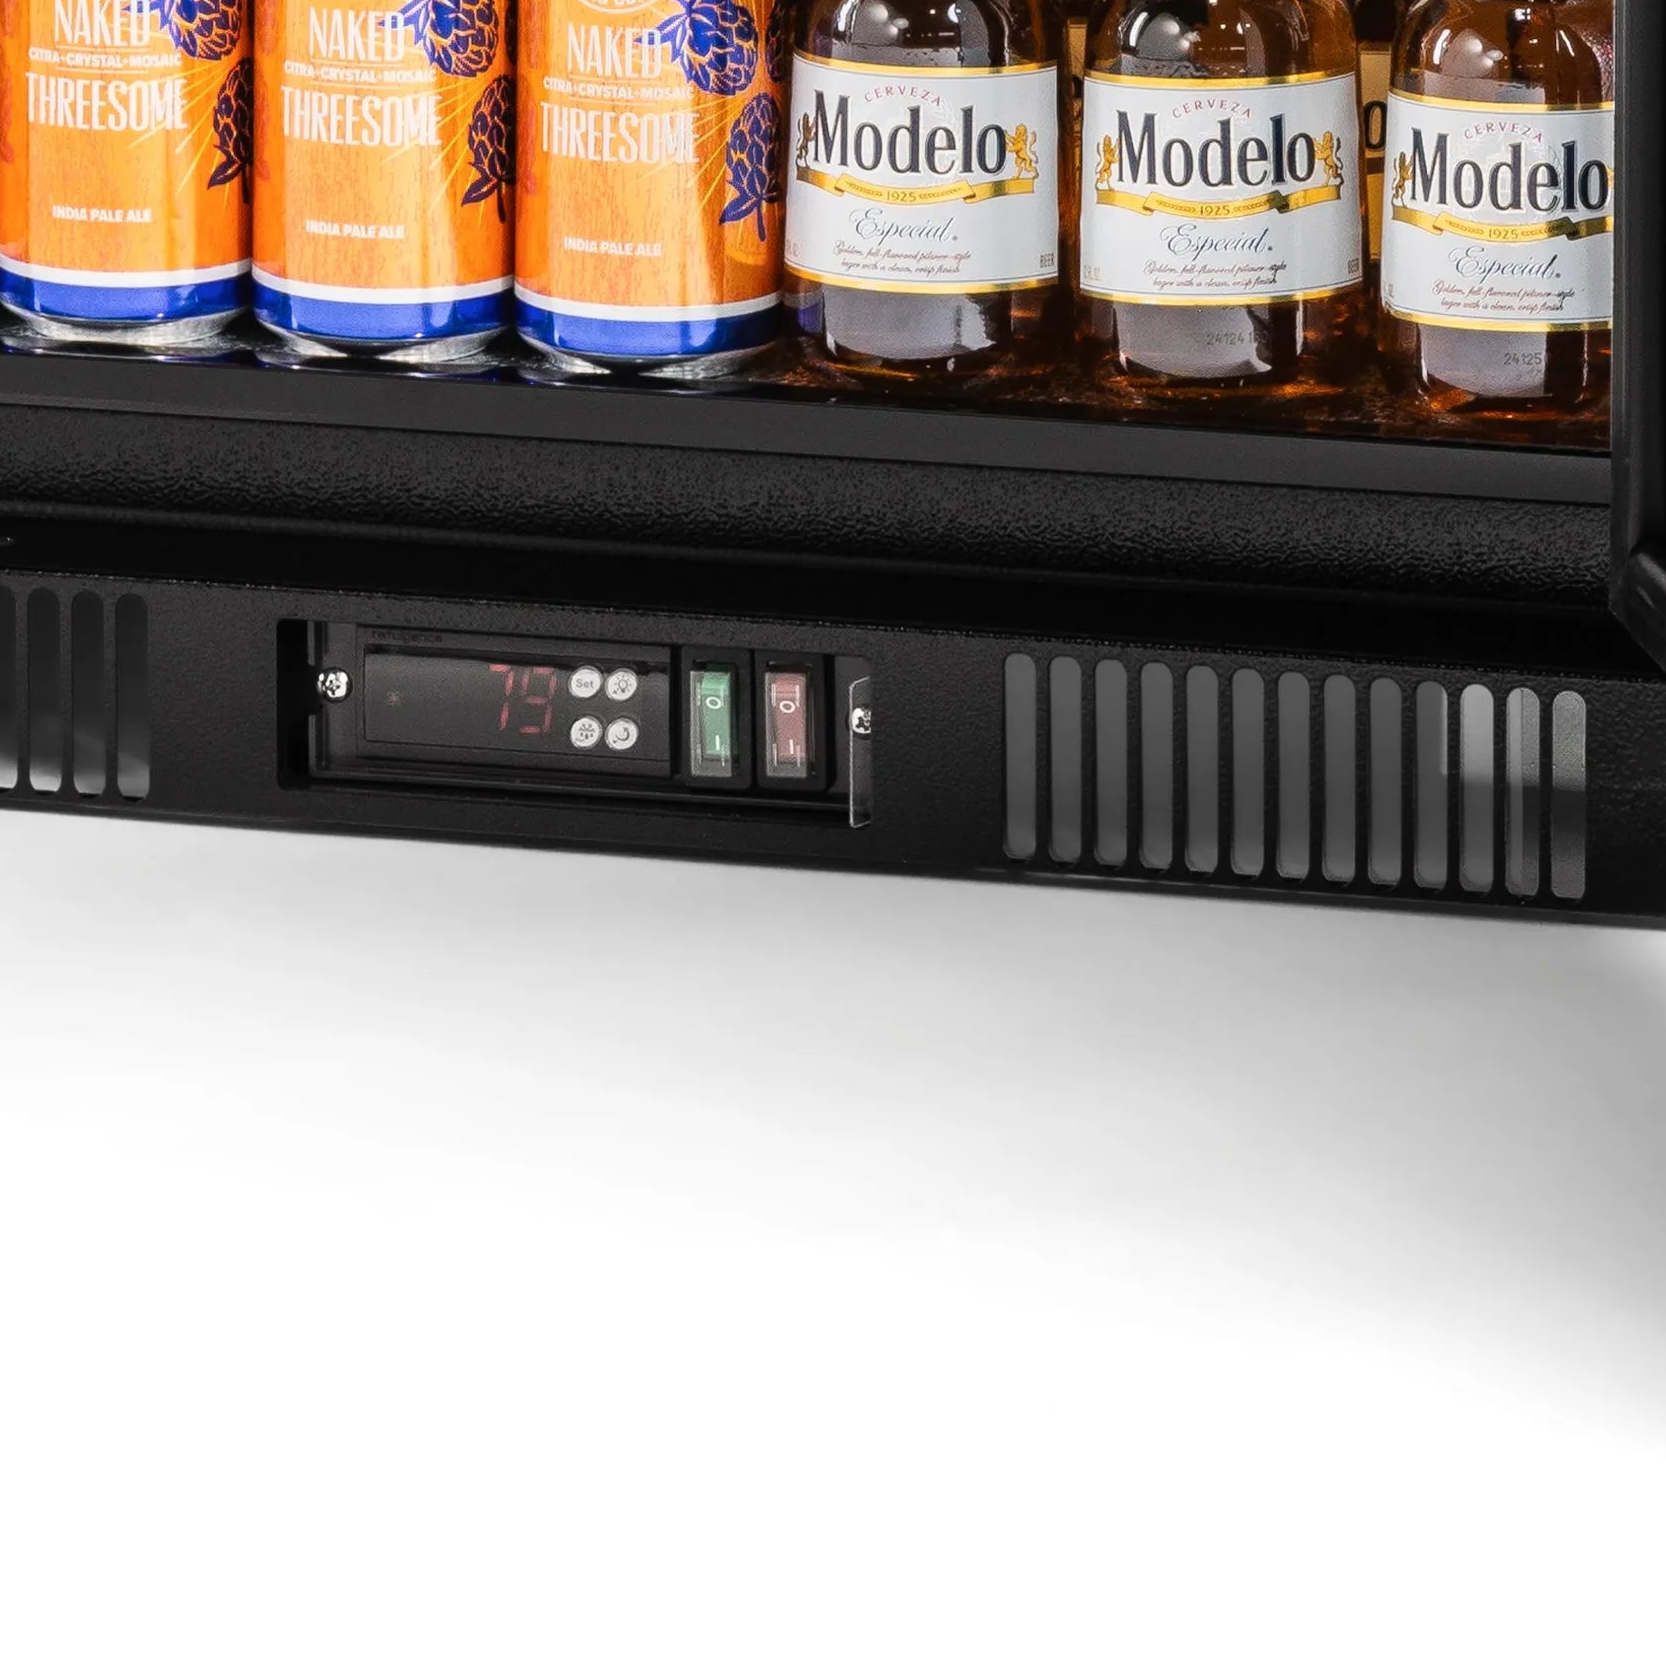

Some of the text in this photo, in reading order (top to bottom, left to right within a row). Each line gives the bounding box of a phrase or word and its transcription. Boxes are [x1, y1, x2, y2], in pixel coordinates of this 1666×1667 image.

[309, 6, 405, 61] NAKED
[567, 22, 663, 79] NAKED
[25, 71, 188, 131] THREESOME
[281, 85, 442, 146] THREESOME
[864, 84, 942, 107] CERVEZA
[1172, 98, 1252, 119] CERVEZA
[540, 100, 700, 164] THREESOME
[812, 88, 1008, 175] Modelo
[1116, 108, 1316, 188] Modelo
[1464, 121, 1544, 144] CERVEZA
[886, 191, 917, 203] 1925
[1410, 126, 1610, 213] Modelo
[52, 205, 152, 223] INDIA PALE ALE
[1199, 204, 1230, 216] 1925
[1488, 228, 1519, 240] 1925
[488, 662, 557, 735] 79
[574, 676, 595, 690] Set
